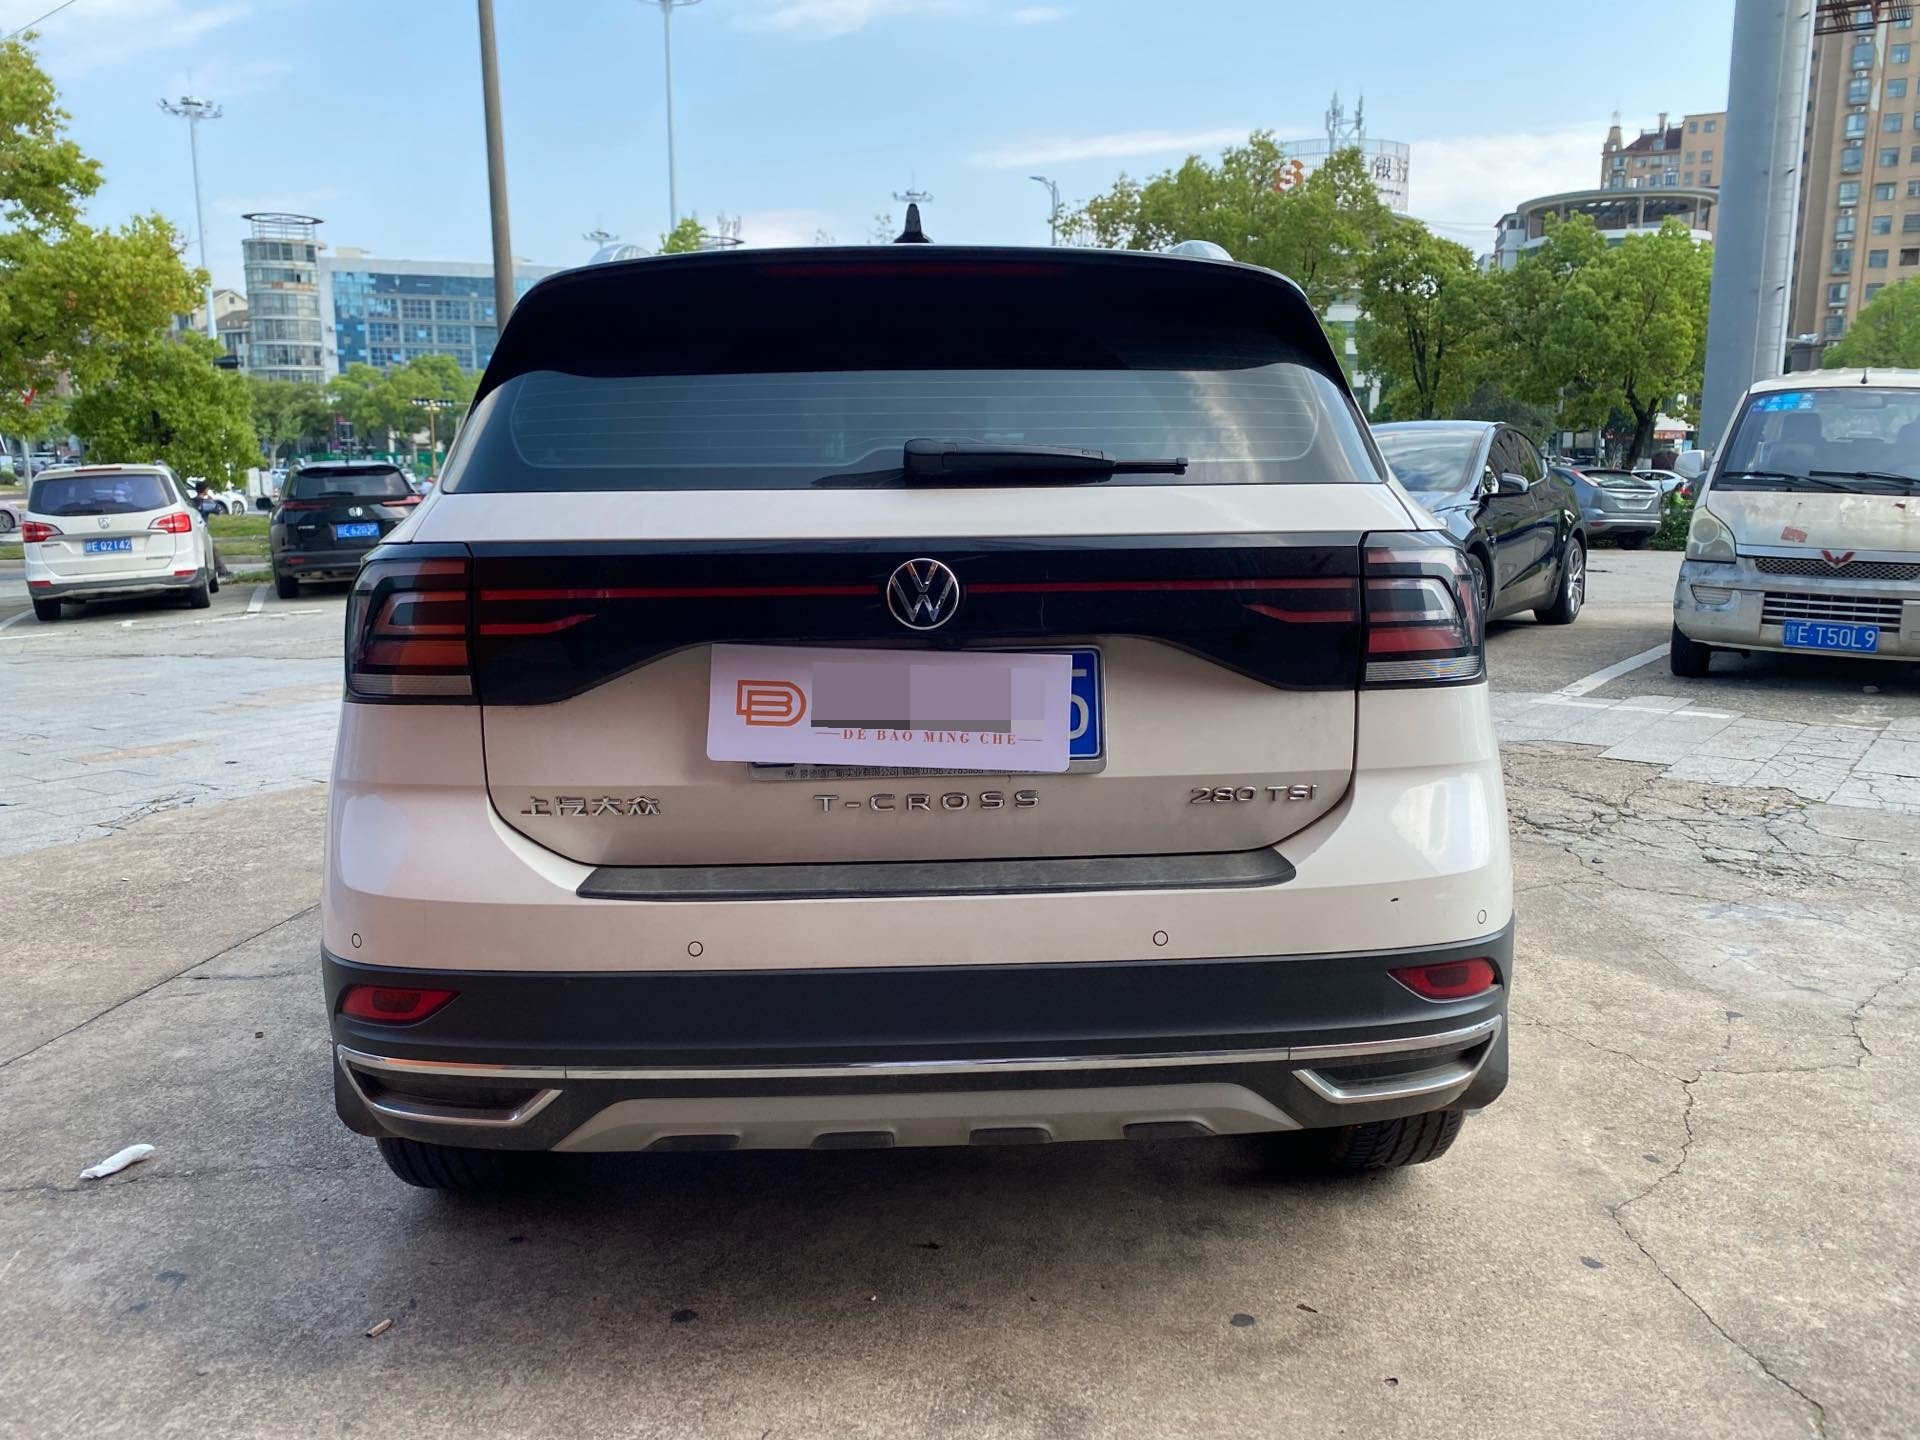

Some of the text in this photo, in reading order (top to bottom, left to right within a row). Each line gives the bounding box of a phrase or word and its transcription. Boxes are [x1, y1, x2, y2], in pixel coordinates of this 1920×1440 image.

[842, 728, 1017, 745] DE BAO MING CHE
[813, 789, 1040, 812] T-CROSS
[1190, 786, 1256, 804] 280
[520, 795, 662, 817] 上汽大众
